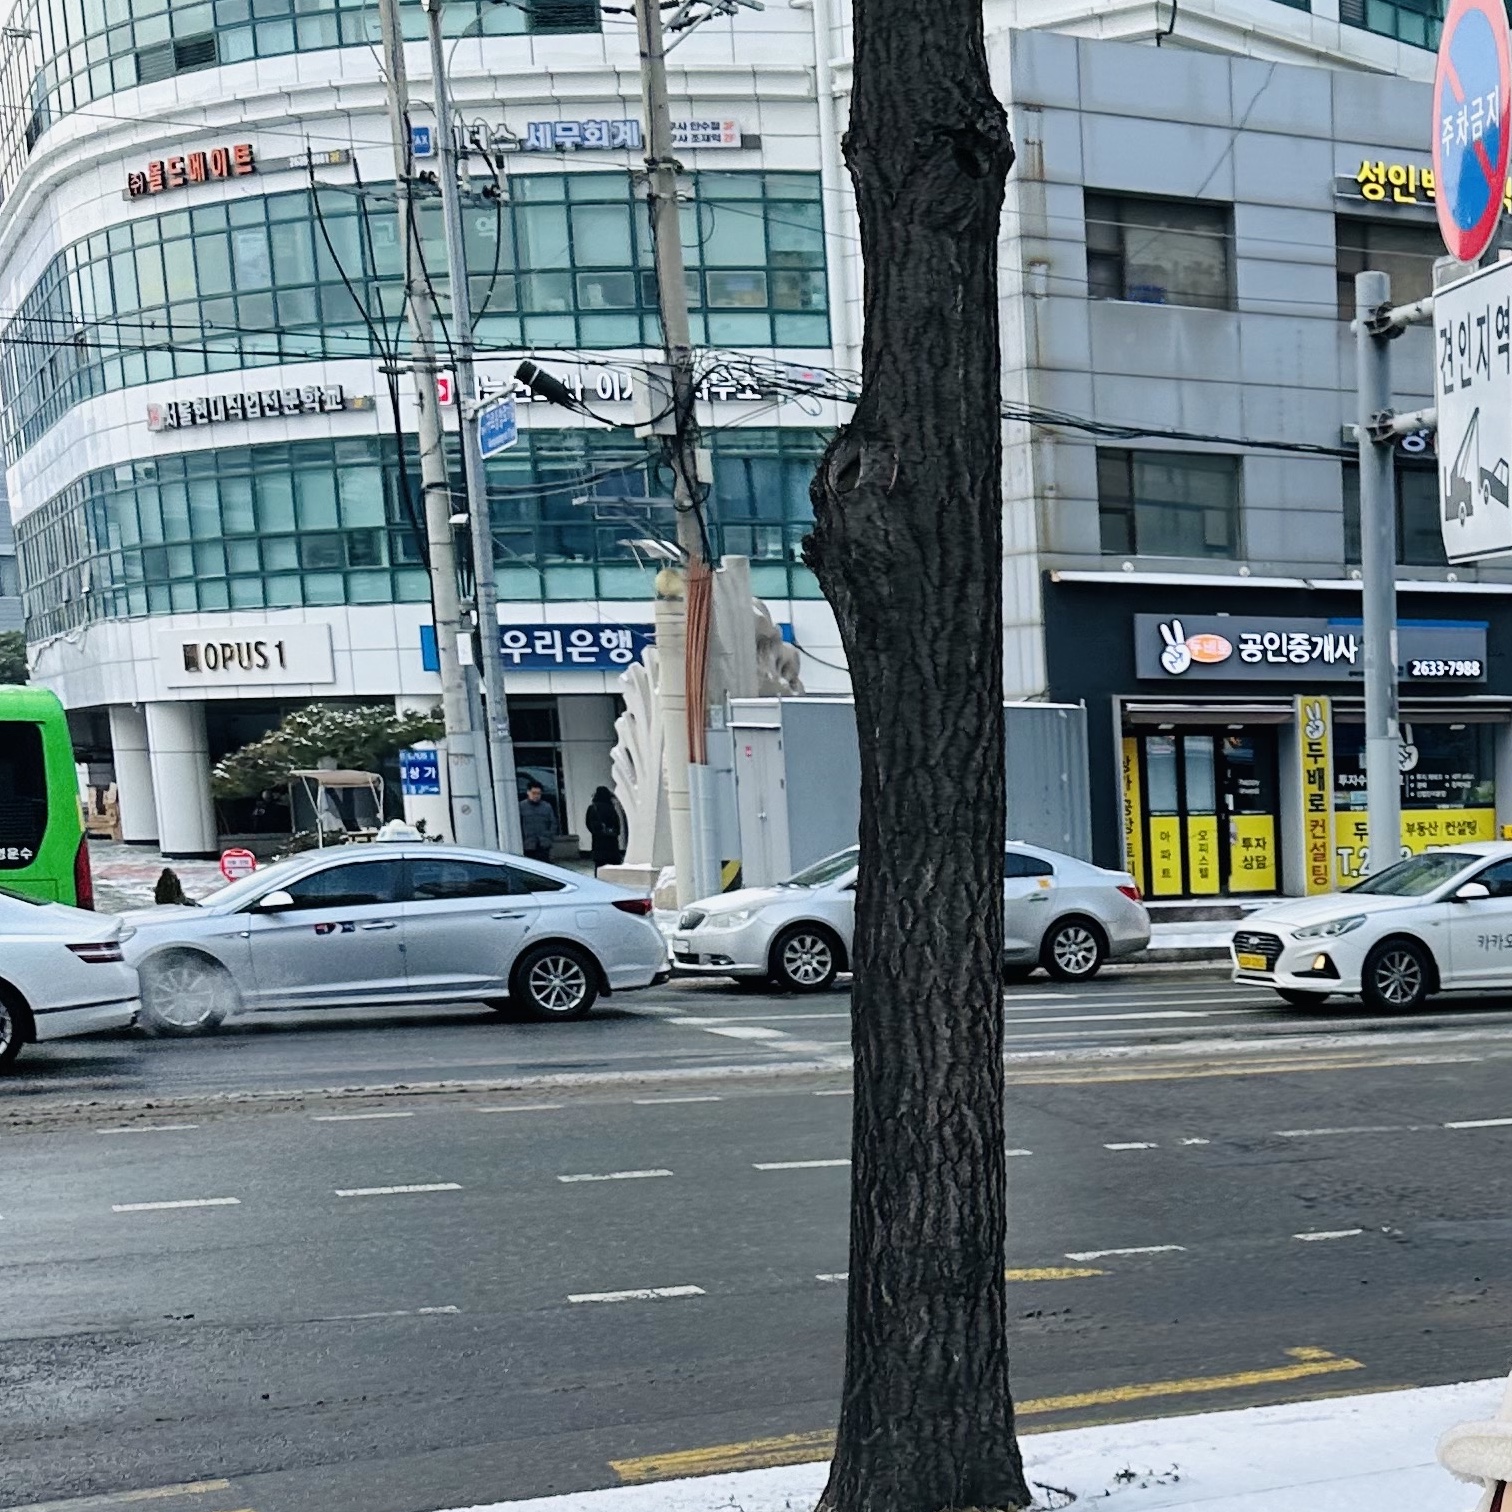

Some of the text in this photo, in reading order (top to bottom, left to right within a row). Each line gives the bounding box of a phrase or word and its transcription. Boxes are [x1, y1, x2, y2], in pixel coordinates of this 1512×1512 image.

[525, 118, 643, 151] 세무회계
[1440, 84, 1500, 157] 주차금지
[1439, 295, 1511, 395] 견인지역
[204, 640, 287, 672] OPUS 1
[501, 630, 634, 664] 우리은행
[1239, 632, 1359, 665] 공인중개사
[1411, 660, 1481, 677] 2633-7988
[1306, 741, 1327, 813] 두배로
[1241, 837, 1267, 851] 투자
[1405, 820, 1439, 837] 부동산
[1444, 819, 1478, 837] 컨설팅
[1159, 831, 1172, 879] 아파트
[1197, 829, 1209, 879] 오피스텔
[1241, 855, 1267, 870] 상담
[1309, 818, 1328, 886] 컨설팅
